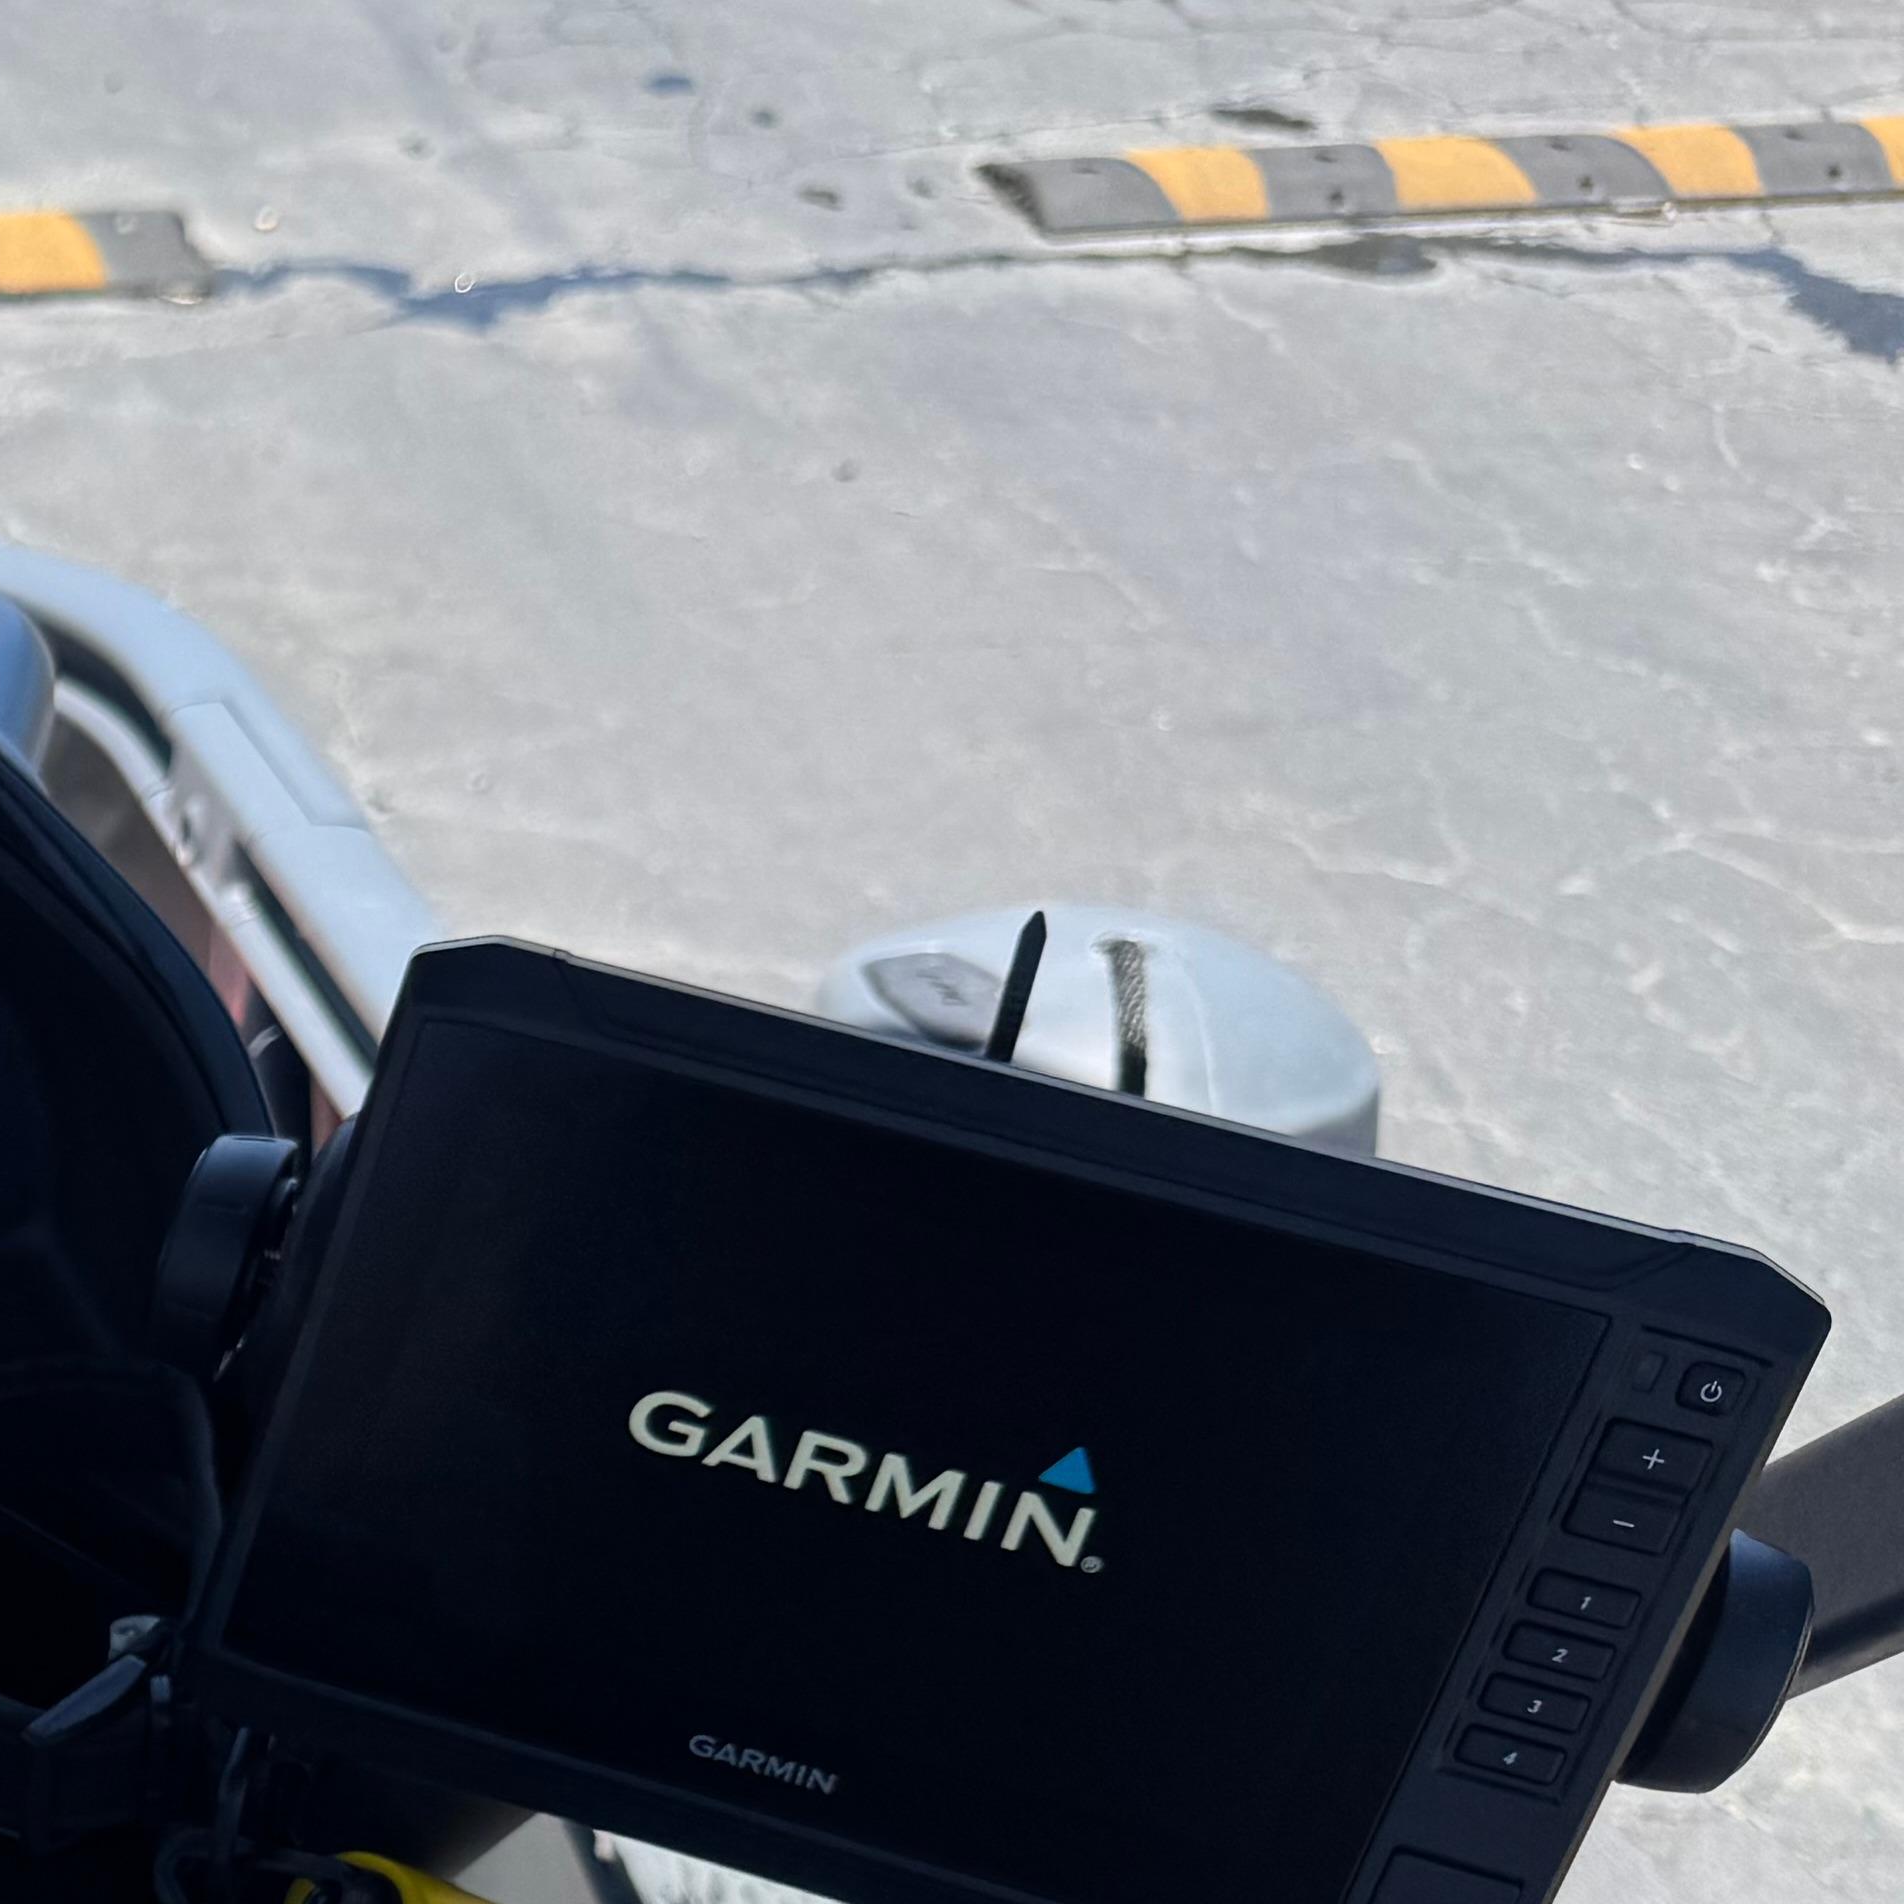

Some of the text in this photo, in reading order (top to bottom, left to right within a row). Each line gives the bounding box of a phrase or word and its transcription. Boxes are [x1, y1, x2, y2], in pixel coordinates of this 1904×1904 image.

[1580, 1596, 1592, 1611] 1
[1552, 1648, 1568, 1664] 2
[1527, 1699, 1542, 1715] 3
[688, 1734, 837, 1795] GARMIN
[1503, 1751, 1518, 1767] 4
